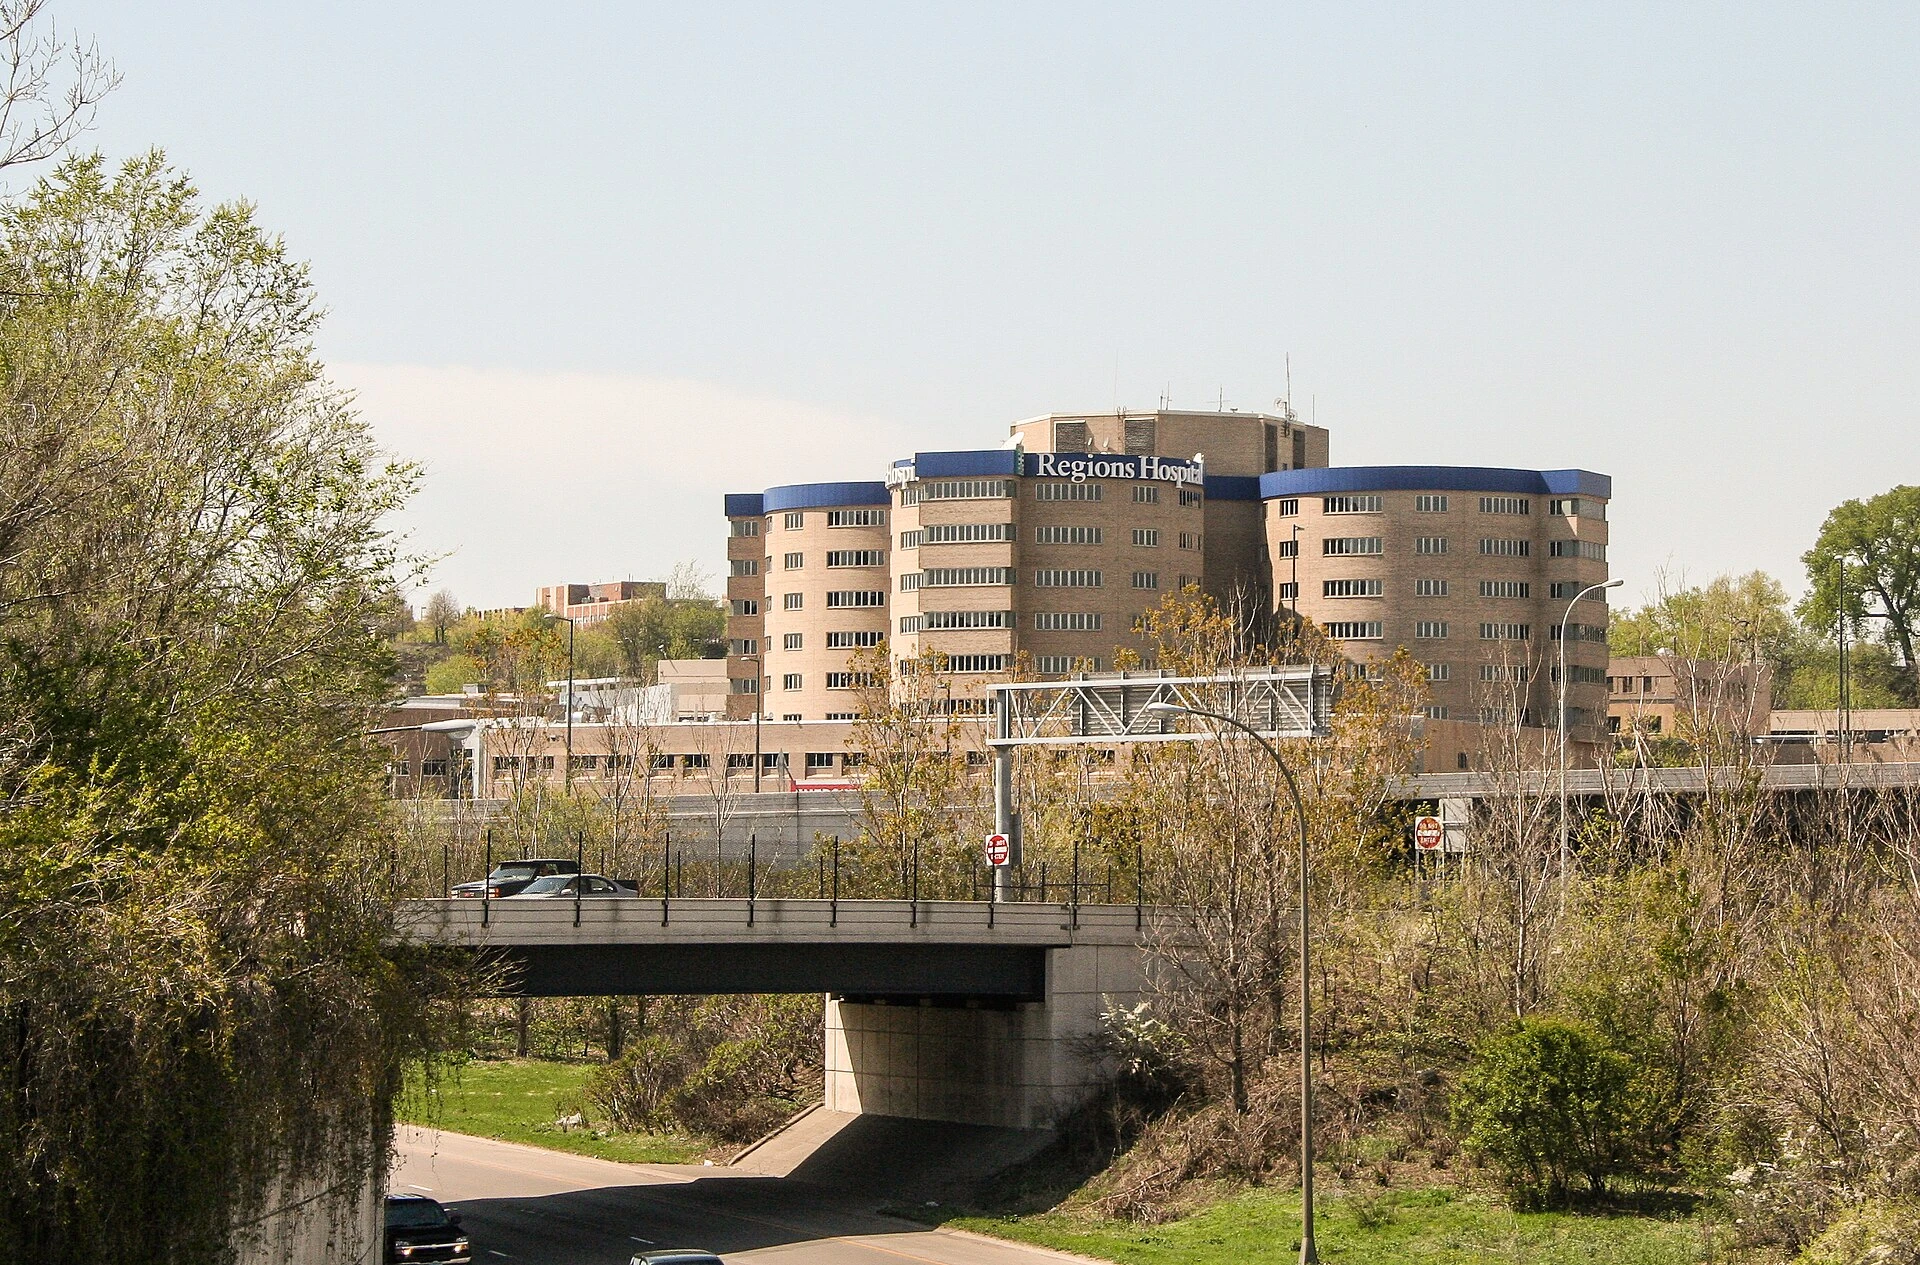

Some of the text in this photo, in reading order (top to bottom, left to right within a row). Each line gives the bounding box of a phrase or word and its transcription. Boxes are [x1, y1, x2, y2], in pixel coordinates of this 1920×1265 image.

[884, 460, 919, 489] Hospi
[1036, 453, 1203, 488] Regions Hospital
